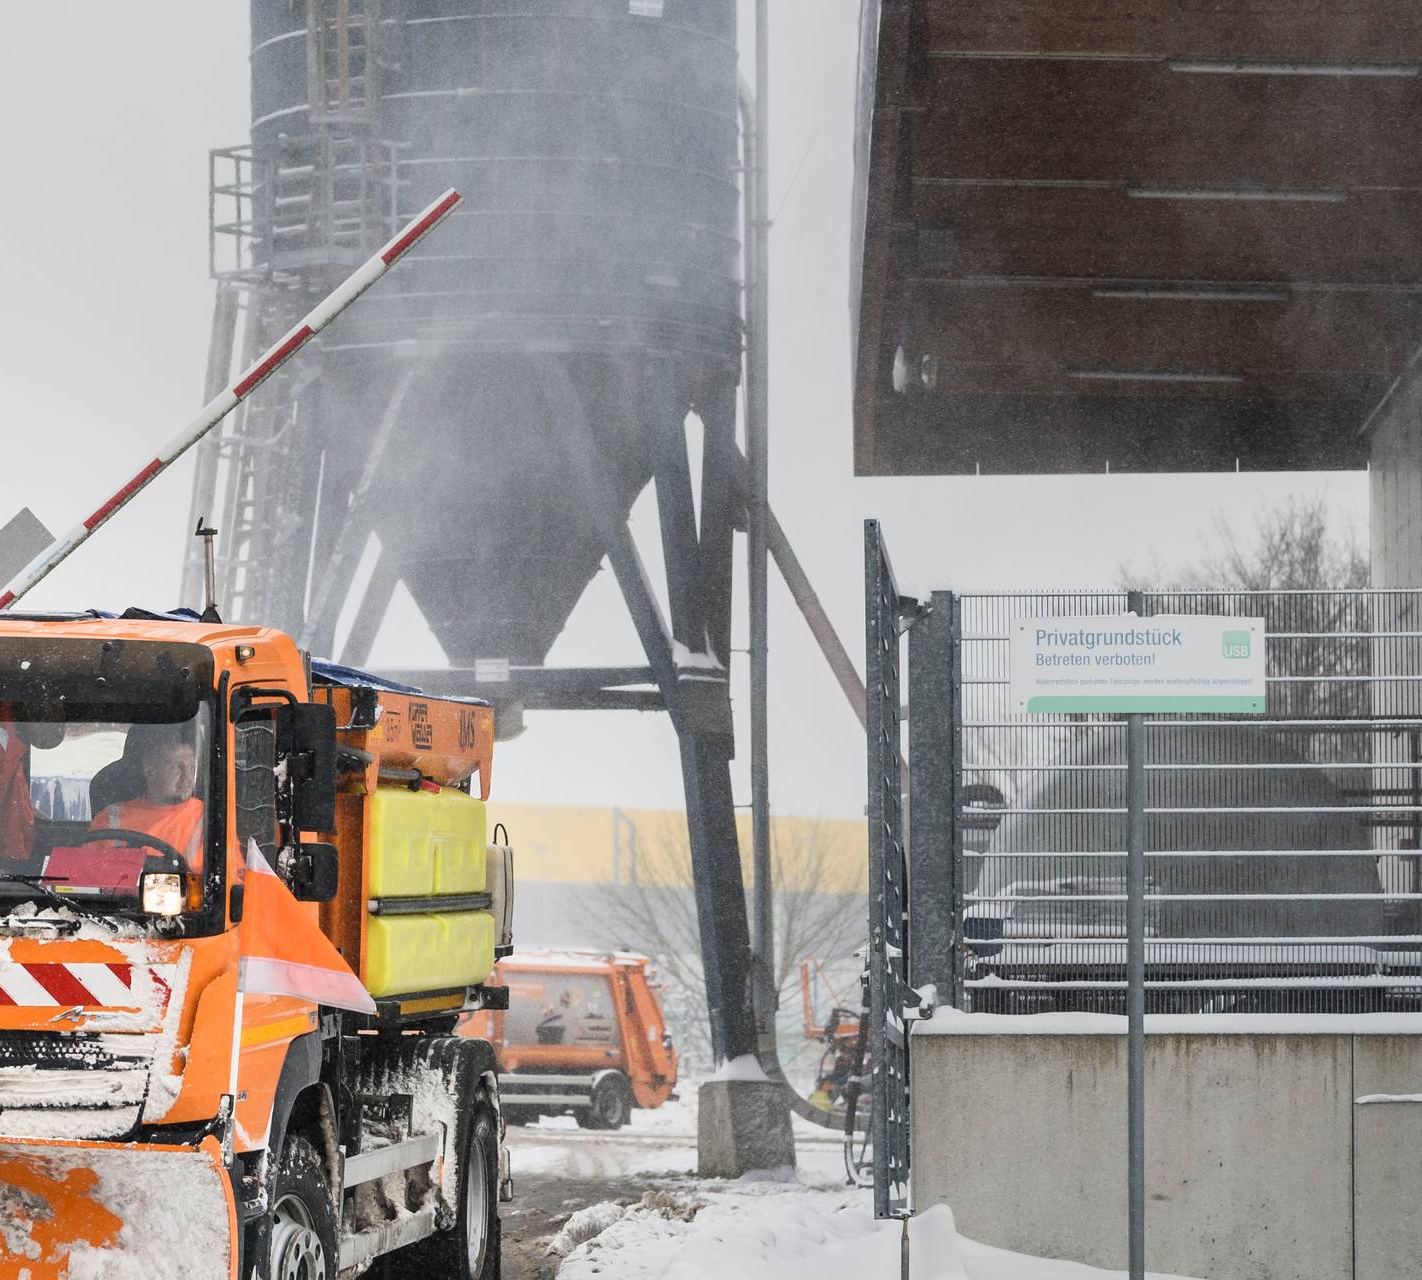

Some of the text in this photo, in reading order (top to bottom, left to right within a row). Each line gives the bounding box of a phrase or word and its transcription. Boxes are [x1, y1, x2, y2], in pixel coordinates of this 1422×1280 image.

[1035, 629, 1183, 649] Privatgrundstück
[1224, 645, 1249, 658] USB
[1035, 653, 1155, 666] Betreten verboten!
